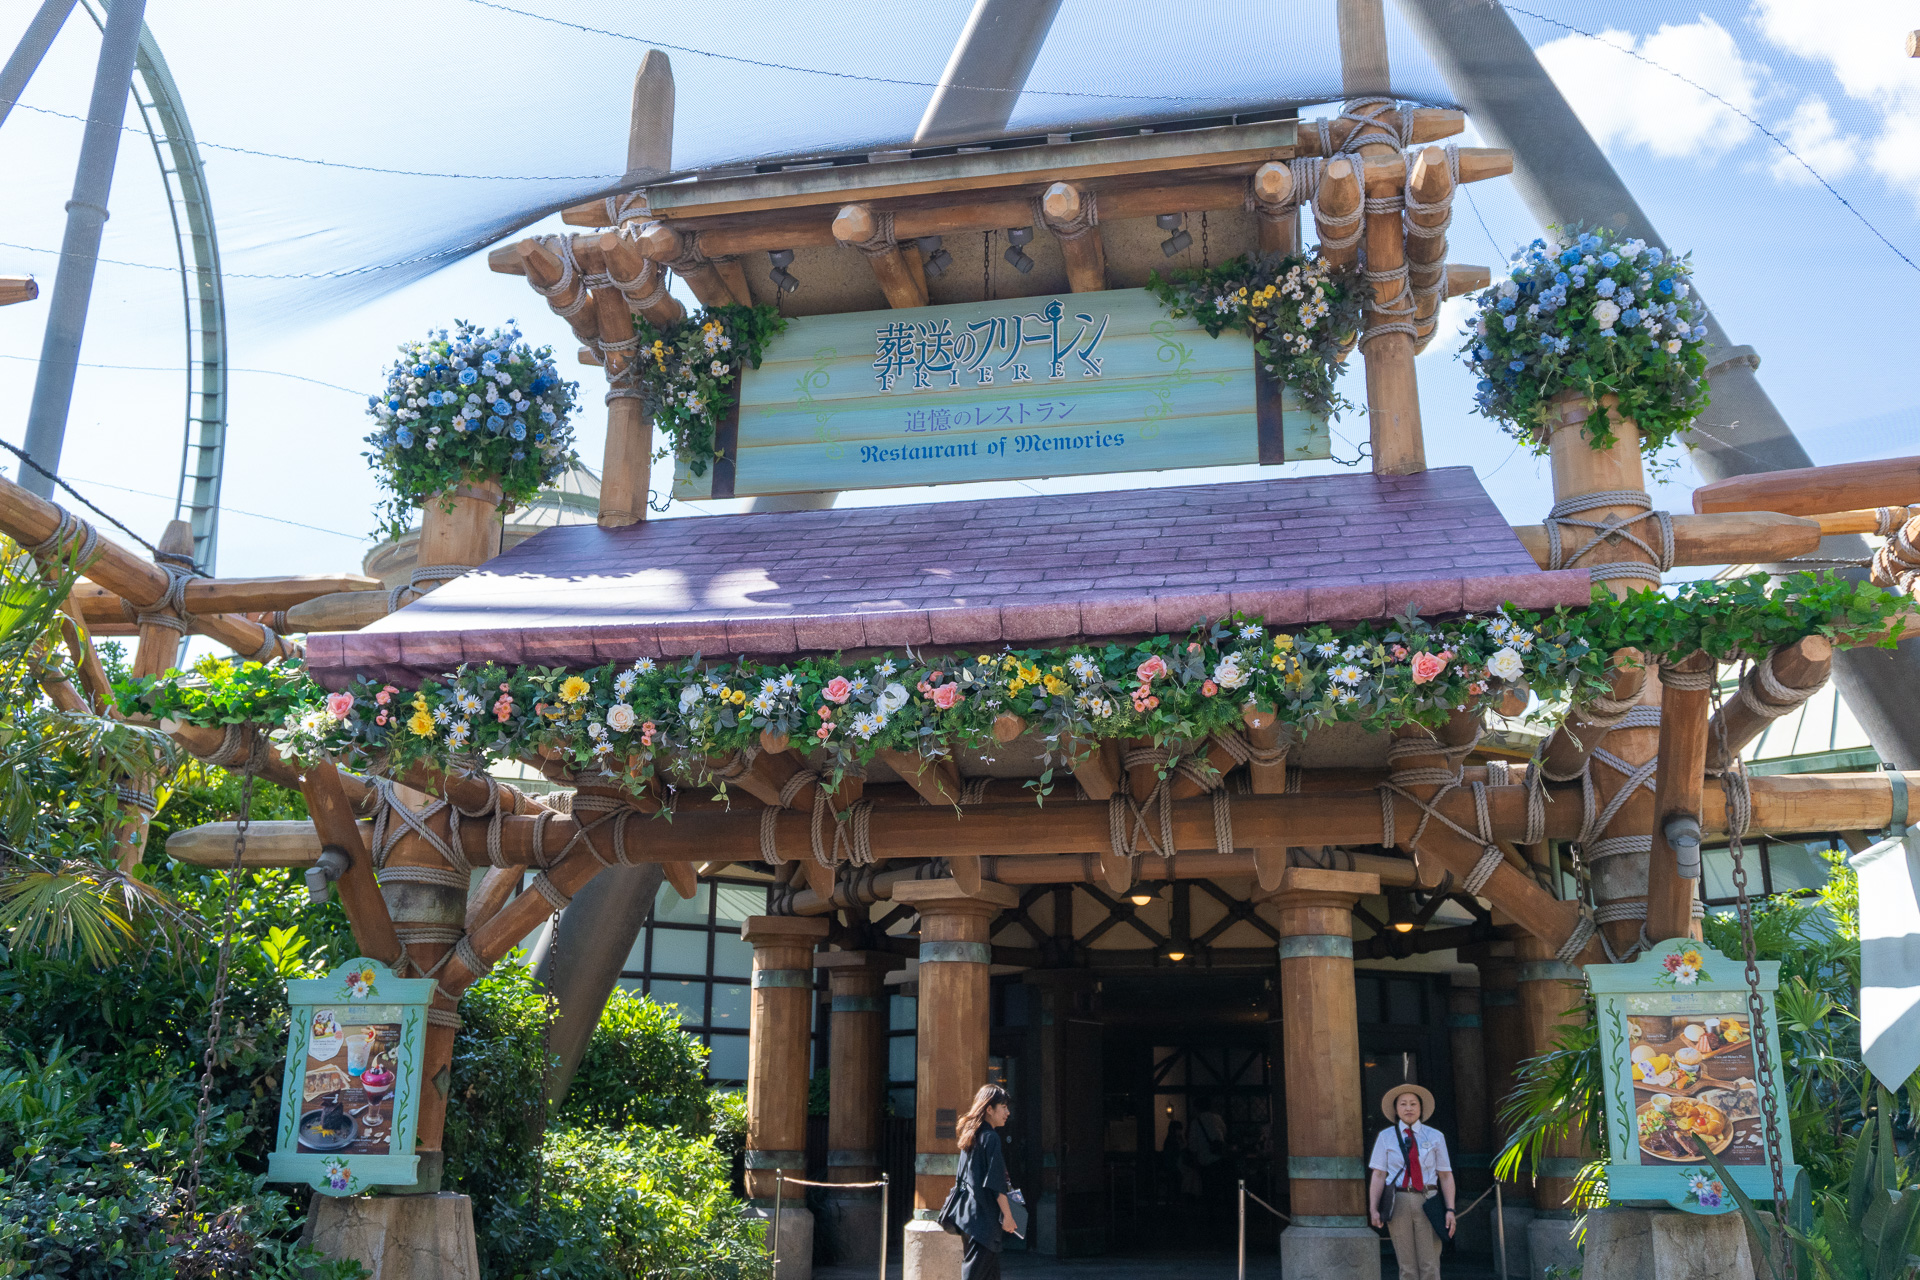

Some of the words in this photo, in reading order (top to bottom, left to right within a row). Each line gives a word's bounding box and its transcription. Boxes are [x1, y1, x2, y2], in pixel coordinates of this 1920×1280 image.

[873, 300, 1110, 377] 葬送のフリーレン
[875, 358, 1104, 393] FRIEREN
[904, 402, 1078, 433] 追憶のレストラン
[860, 439, 978, 464] Restaurant
[987, 437, 1008, 459] of
[1014, 430, 1126, 453] Memories
